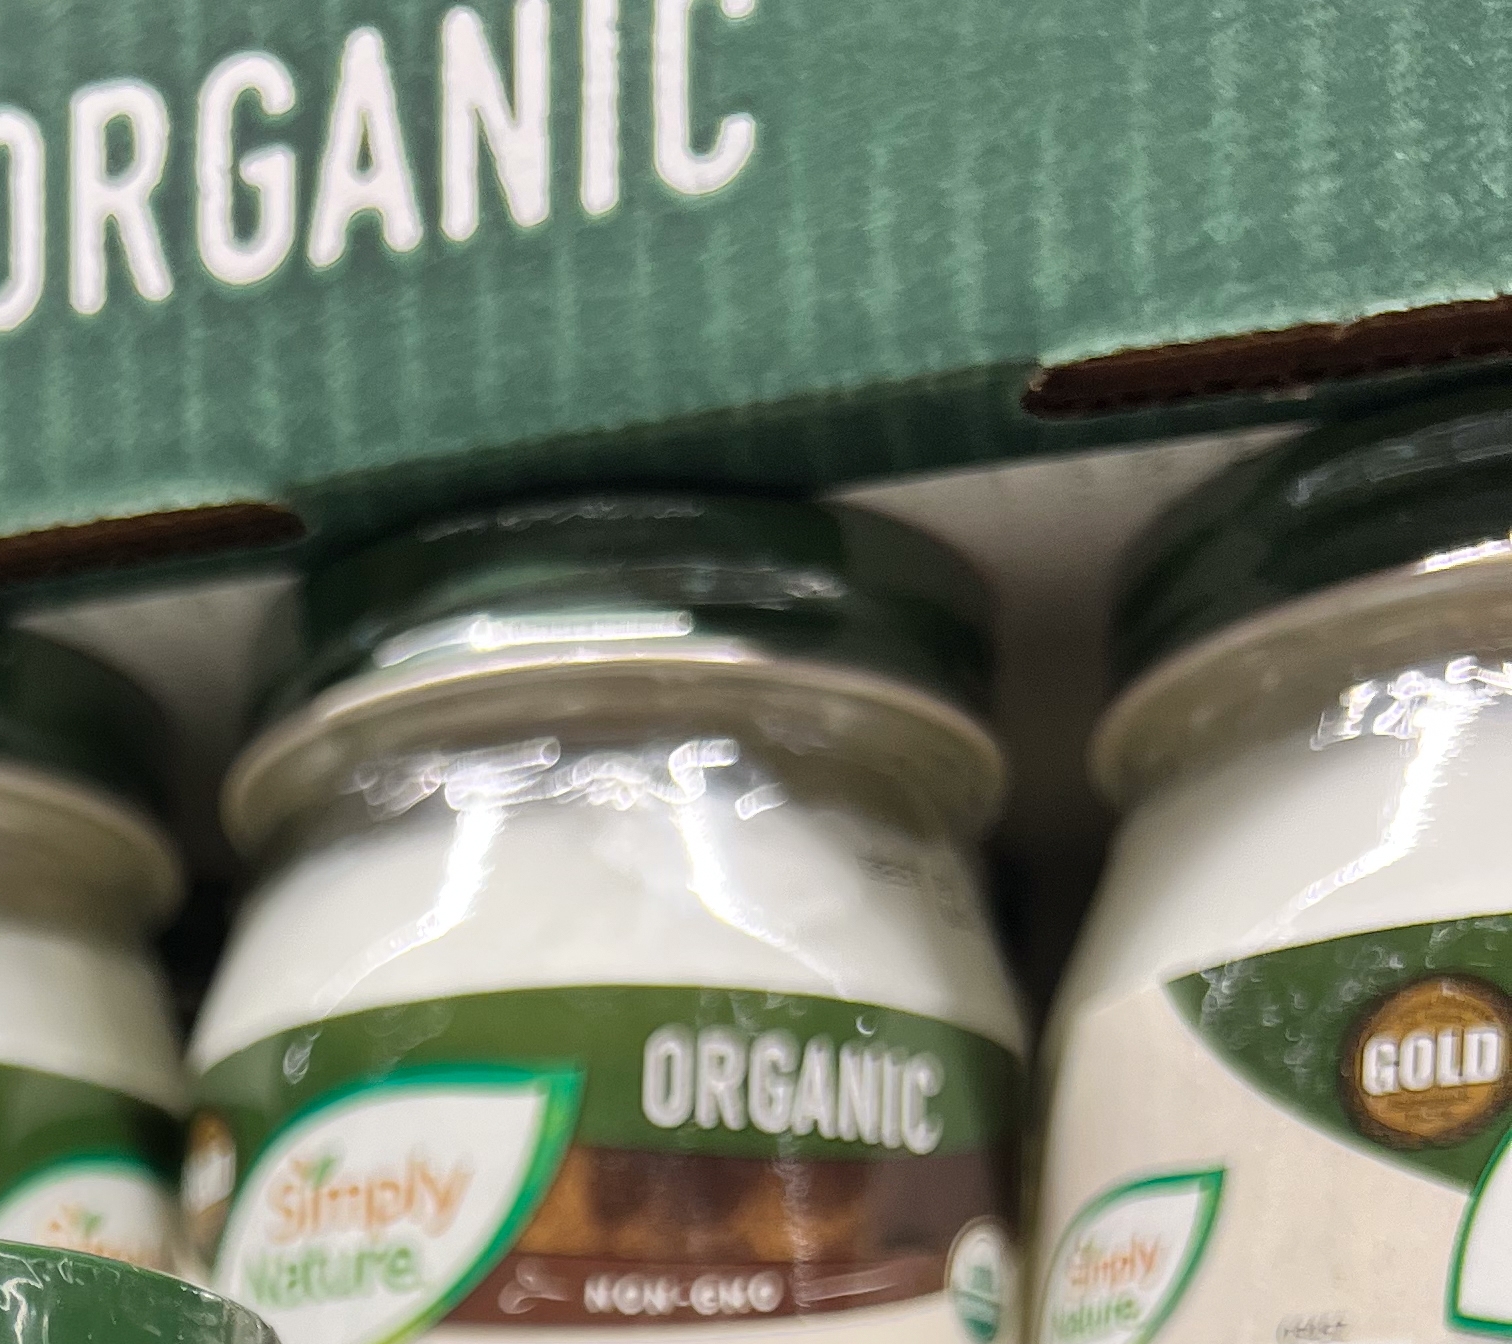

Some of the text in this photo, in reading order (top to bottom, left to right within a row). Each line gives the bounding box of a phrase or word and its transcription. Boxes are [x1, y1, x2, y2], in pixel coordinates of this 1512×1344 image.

[643, 1023, 944, 1155] ORGANIC
[1361, 1027, 1503, 1097] GOLD
[266, 1155, 475, 1244] Simply
[584, 1270, 785, 1316] NON-GMO
